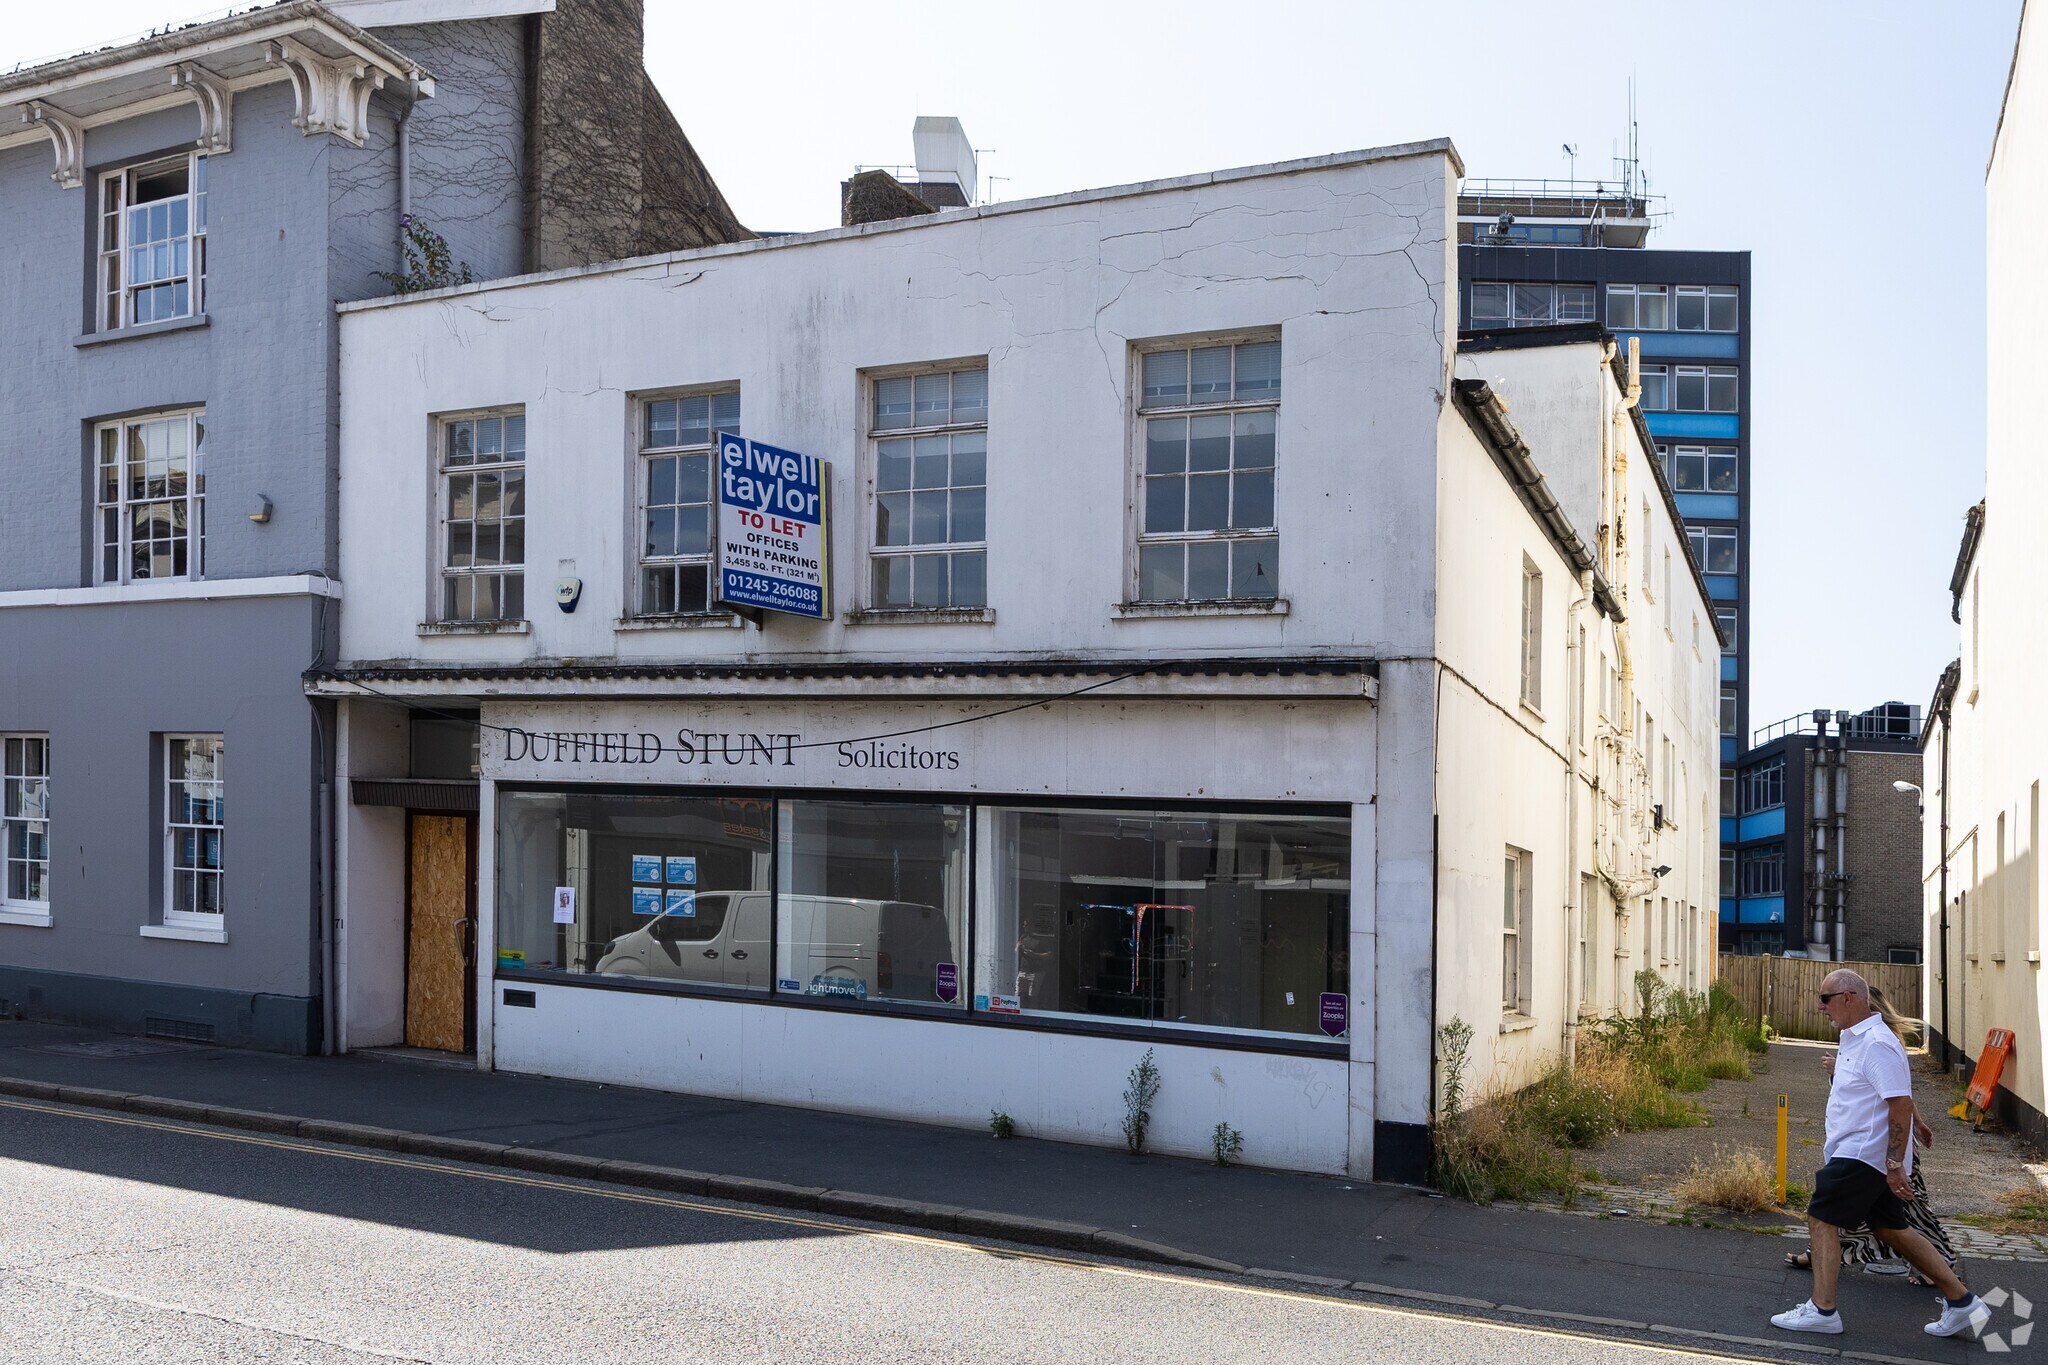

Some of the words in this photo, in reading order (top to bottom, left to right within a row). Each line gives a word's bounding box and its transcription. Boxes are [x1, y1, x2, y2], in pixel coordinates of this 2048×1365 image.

[724, 439, 816, 486] elwell
[723, 467, 818, 515] taylor
[738, 510, 764, 529] TO
[771, 517, 806, 538] LET
[747, 532, 799, 551] OFFICES
[726, 556, 750, 567] 3,455
[753, 561, 768, 571] SQ.
[771, 565, 784, 574] FT.
[786, 568, 804, 578] (321
[727, 542, 760, 558] WITH
[764, 550, 818, 569] PARKING
[728, 574, 769, 592] 01245
[772, 582, 818, 602] 266088
[729, 589, 817, 611] www.elwelltaylor.co.uk
[504, 727, 662, 765] DUFFIELD
[676, 728, 801, 766] STUNT
[838, 740, 960, 770] Solicitors
[335, 918, 344, 929] 71
